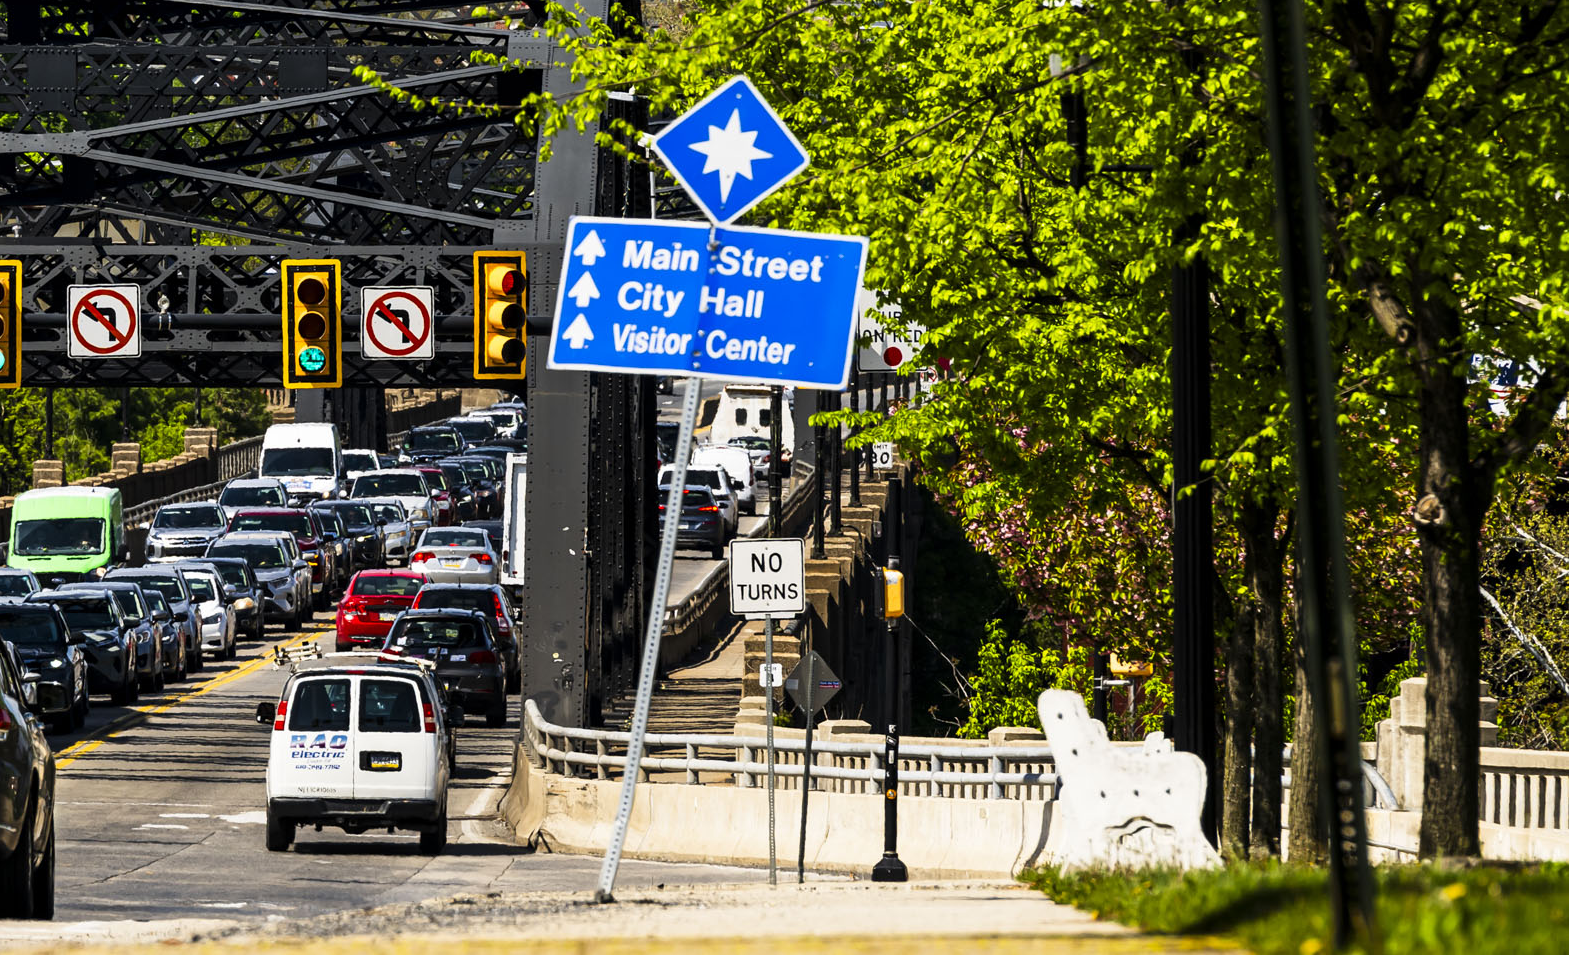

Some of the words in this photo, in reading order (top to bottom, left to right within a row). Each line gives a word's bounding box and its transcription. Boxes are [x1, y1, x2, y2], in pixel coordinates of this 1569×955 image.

[623, 239, 700, 272] Main
[716, 245, 824, 283] Street
[617, 280, 685, 318] City
[698, 285, 765, 319] Hall
[612, 322, 692, 356] Visitor
[705, 329, 796, 365] Center
[871, 451, 890, 465] 30
[751, 552, 783, 573] NO
[736, 583, 799, 601] TURNS
[291, 750, 345, 759] electric
